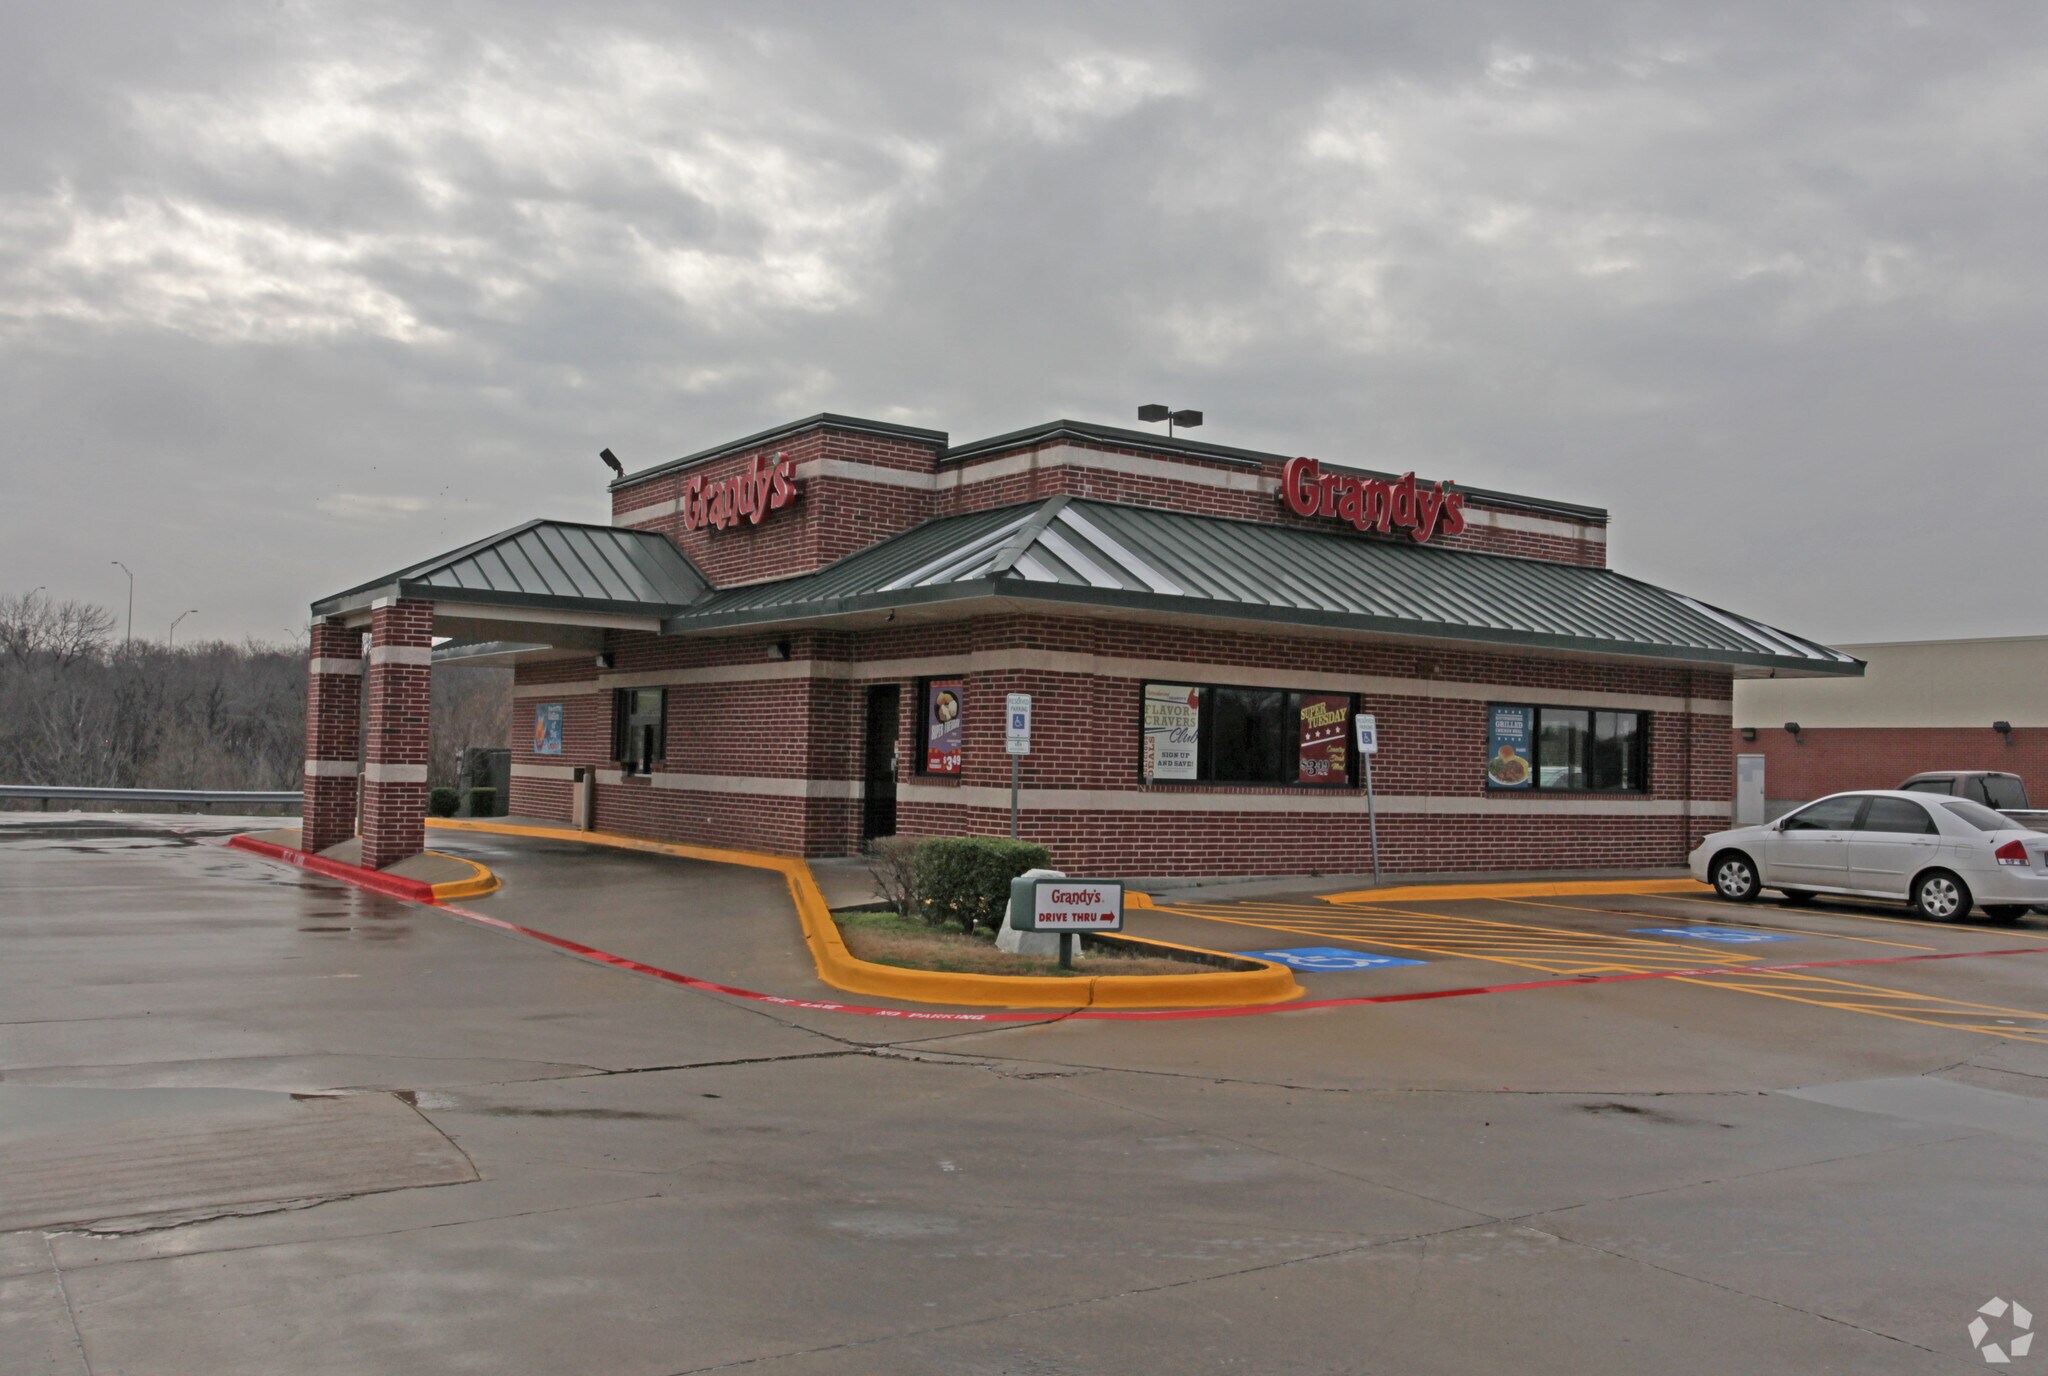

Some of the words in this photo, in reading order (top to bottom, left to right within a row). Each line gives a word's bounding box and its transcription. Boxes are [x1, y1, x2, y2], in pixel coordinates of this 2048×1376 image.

[684, 452, 796, 531] Grandy's
[1282, 456, 1465, 543] Grandy's
[1145, 704, 1190, 716] FLAVOR
[1300, 702, 1327, 720] SUPER
[1308, 707, 1347, 729] TUESDAY
[1144, 716, 1196, 728] CRAVERS
[1495, 721, 1523, 729] GRILLED
[1169, 727, 1199, 744] Club
[1147, 736, 1155, 777] DEALS
[1051, 889, 1101, 905] Grandy's
[1039, 913, 1067, 922] DRIVE
[1071, 913, 1097, 922] THRU
[908, 1012, 987, 1021] PARKING
